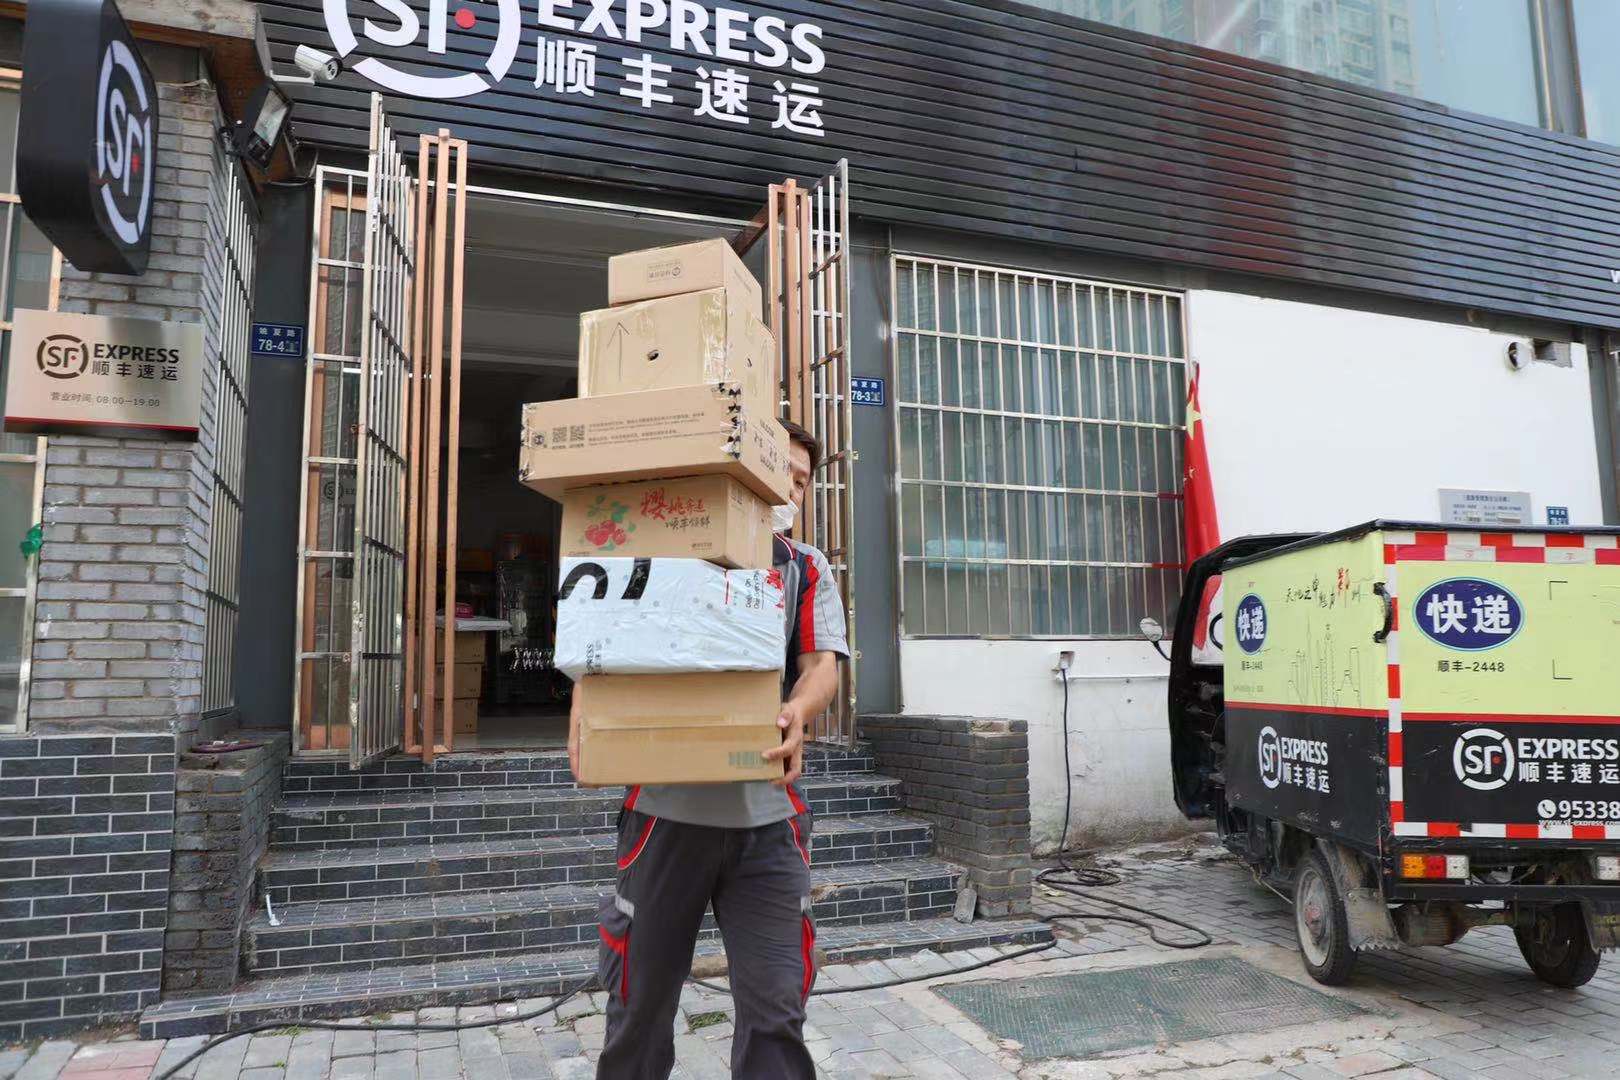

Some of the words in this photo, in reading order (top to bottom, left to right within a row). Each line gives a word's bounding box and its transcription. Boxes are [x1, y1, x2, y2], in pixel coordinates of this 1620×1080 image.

[533, 38, 825, 137] 顺丰速运
[46, 345, 77, 369] SF
[93, 343, 180, 365] EXPRESS
[91, 360, 179, 382] 顺丰速运
[50, 391, 92, 403] 营业时间
[1237, 605, 1266, 643] 快递
[1426, 593, 1513, 635] 快递
[1437, 660, 1505, 673] 顺丰-2448
[1281, 736, 1328, 766] EXPRESS
[1464, 744, 1503, 775] SF
[1518, 738, 1620, 760] EXPRESS
[1282, 762, 1330, 794] 顺丰速运
[1518, 762, 1620, 784] 顺丰速运
[1558, 800, 1620, 819] 95338
